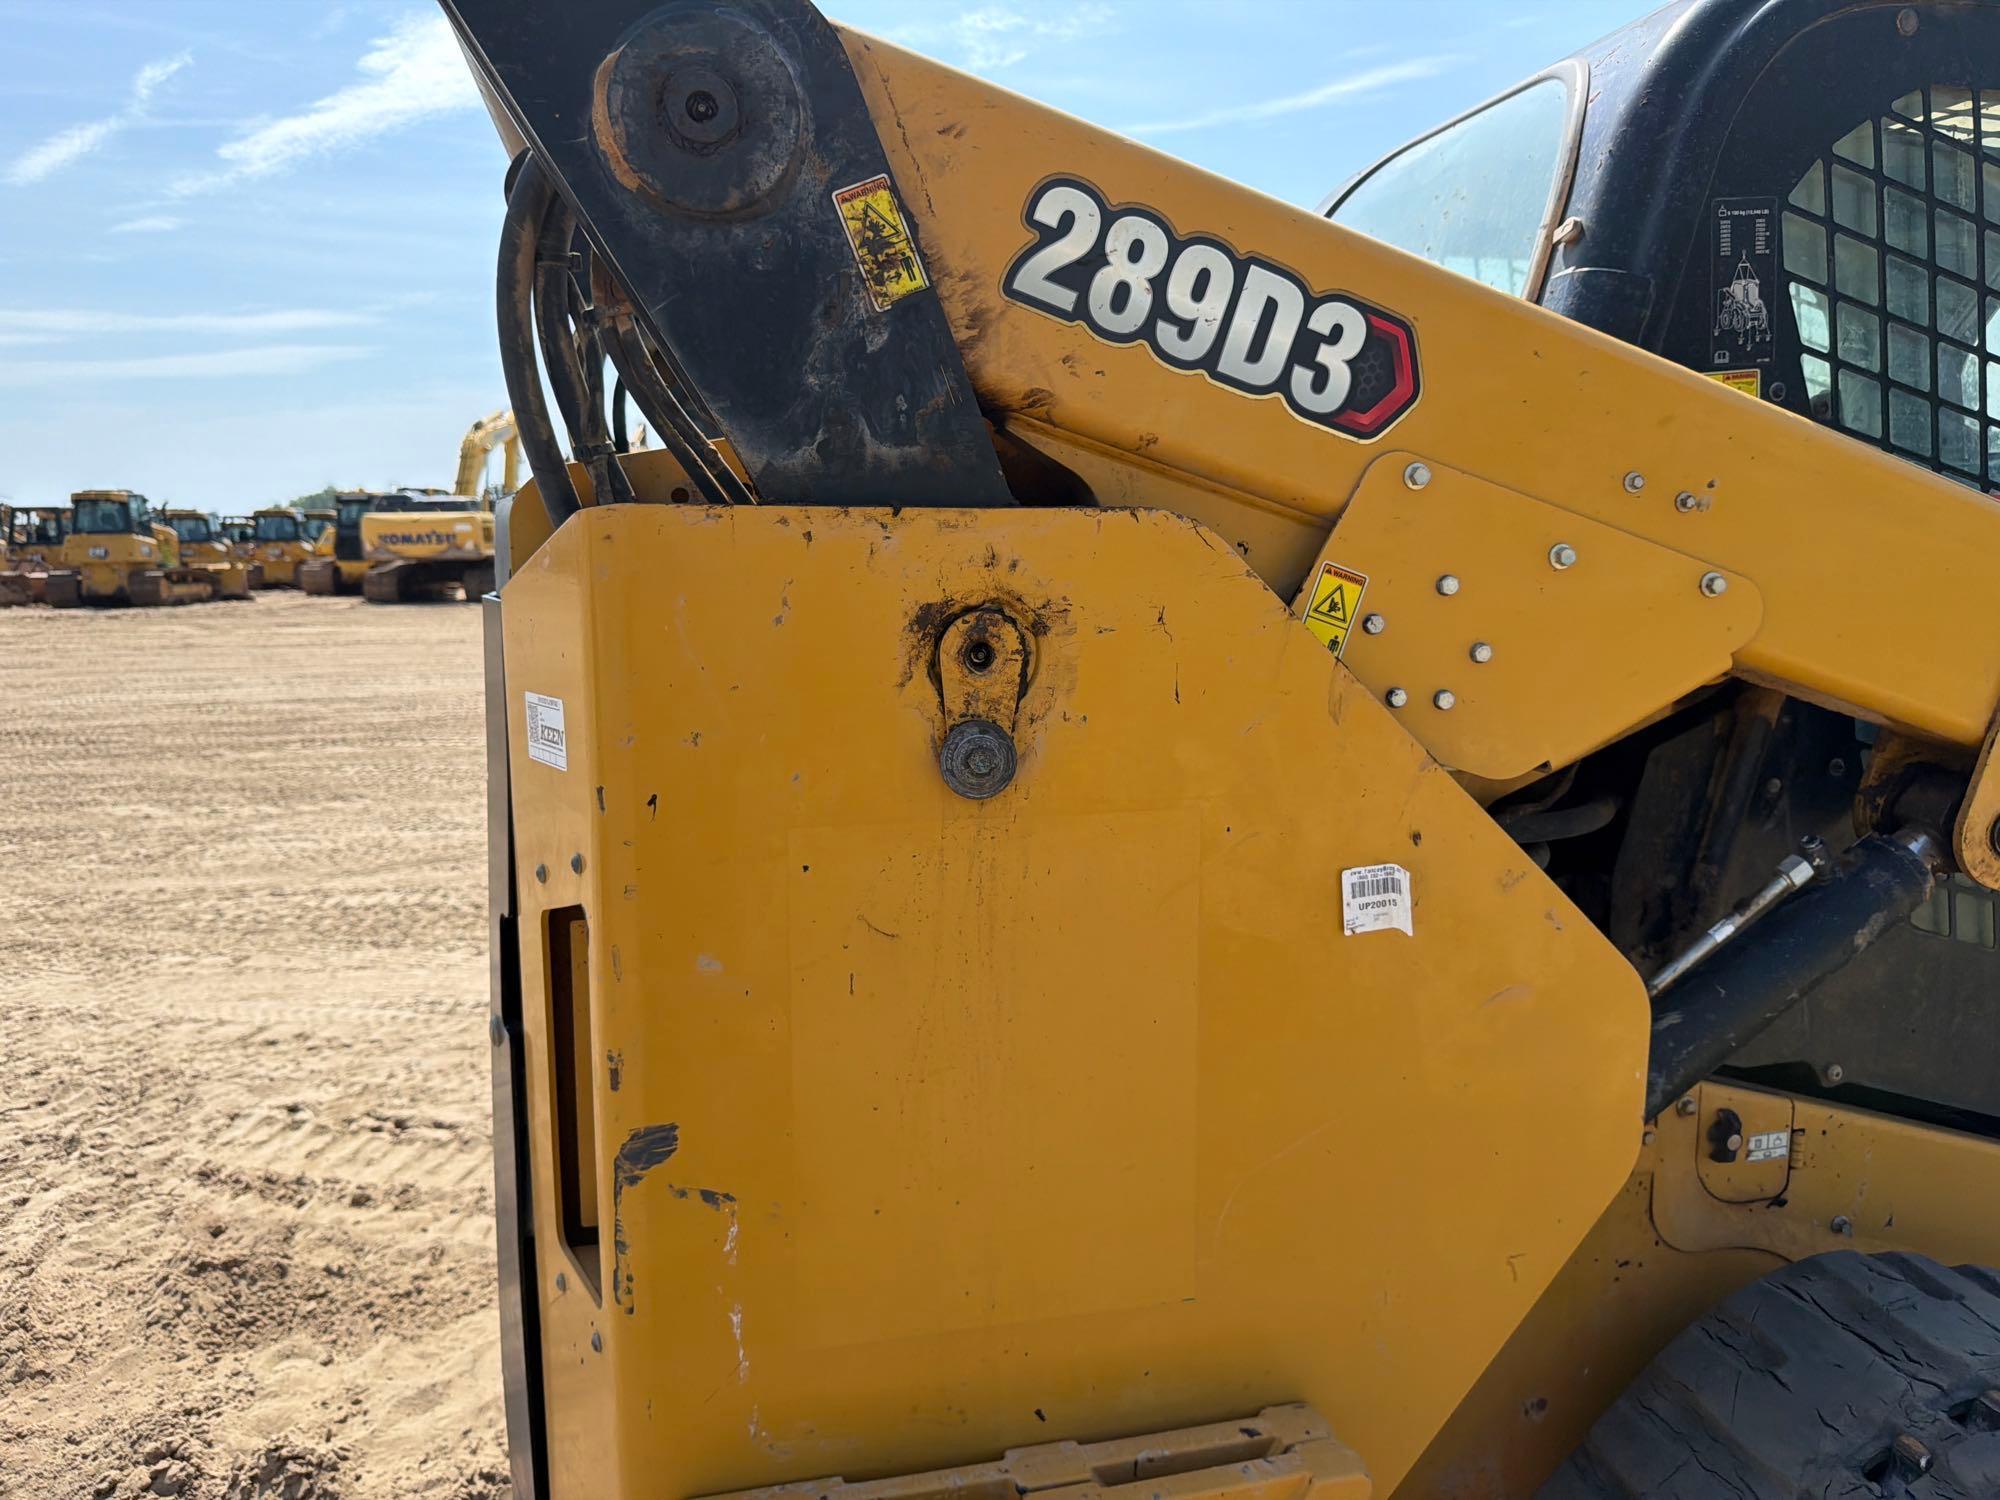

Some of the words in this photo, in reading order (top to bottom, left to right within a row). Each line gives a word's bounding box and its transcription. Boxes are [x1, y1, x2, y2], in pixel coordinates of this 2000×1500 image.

[849, 181, 886, 200] WARNING
[1012, 186, 1367, 415] 289D3
[1333, 568, 1363, 585] WARNING
[540, 724, 564, 747] KEEN
[1358, 899, 1398, 911] UP20015
